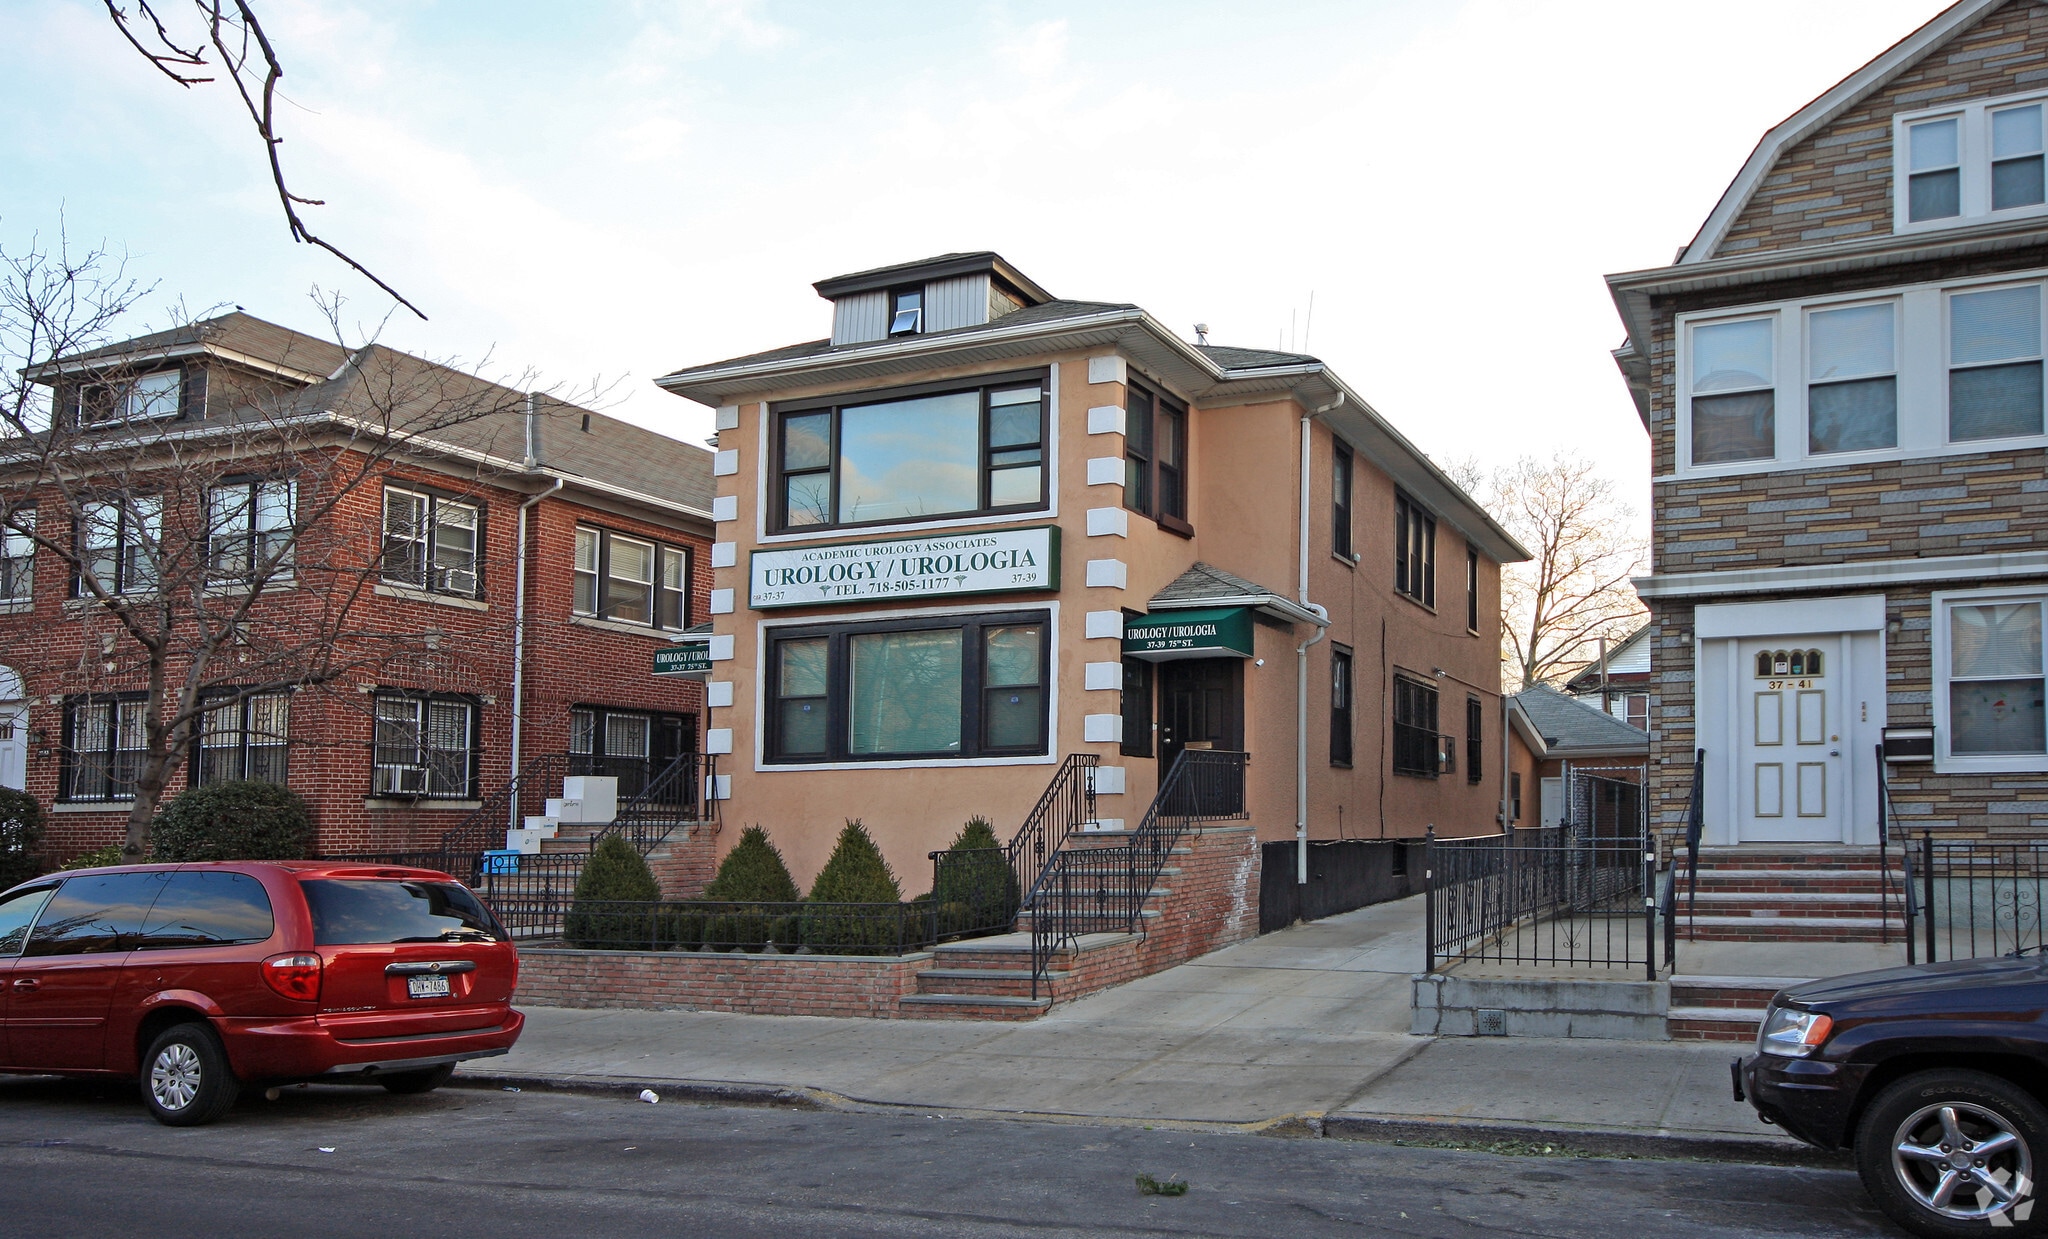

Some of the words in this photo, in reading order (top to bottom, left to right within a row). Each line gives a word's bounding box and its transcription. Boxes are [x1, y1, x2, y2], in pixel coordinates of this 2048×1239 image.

[801, 548, 862, 562] ACADEMIC
[865, 543, 922, 557] UROLOGY
[924, 537, 998, 552] ASSOCIATES
[764, 559, 881, 587] UROLOGY
[901, 549, 1037, 577] UROLOGIA
[1011, 573, 1038, 584] 37-39
[834, 584, 865, 597] TEL.
[868, 577, 950, 594] 718-505-1177
[763, 591, 786, 601] 37-37
[1147, 641, 1166, 649] 37-39
[1182, 639, 1194, 647] ST.
